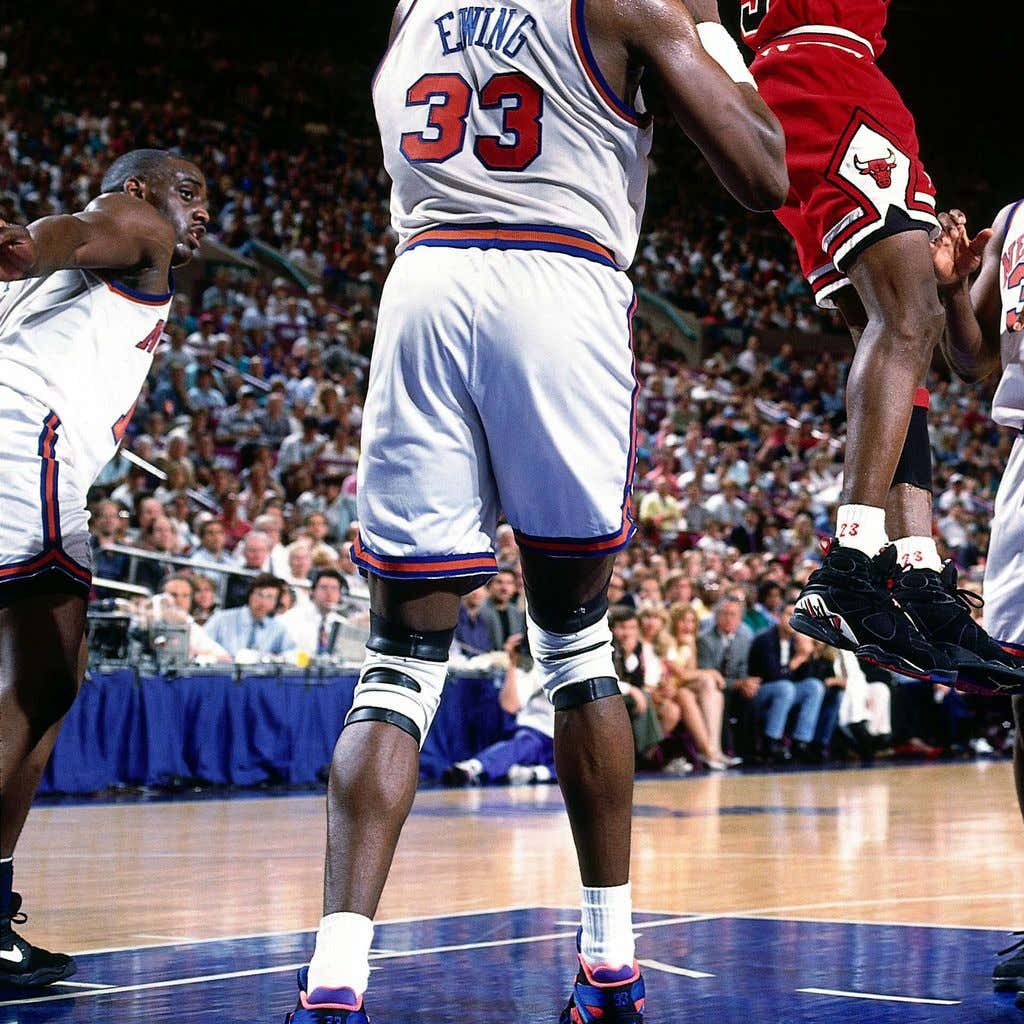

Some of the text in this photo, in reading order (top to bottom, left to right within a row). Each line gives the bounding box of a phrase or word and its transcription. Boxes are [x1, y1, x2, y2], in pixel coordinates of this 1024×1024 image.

[434, 6, 537, 59] EWING
[399, 70, 544, 173] 33
[839, 522, 860, 538] 23
